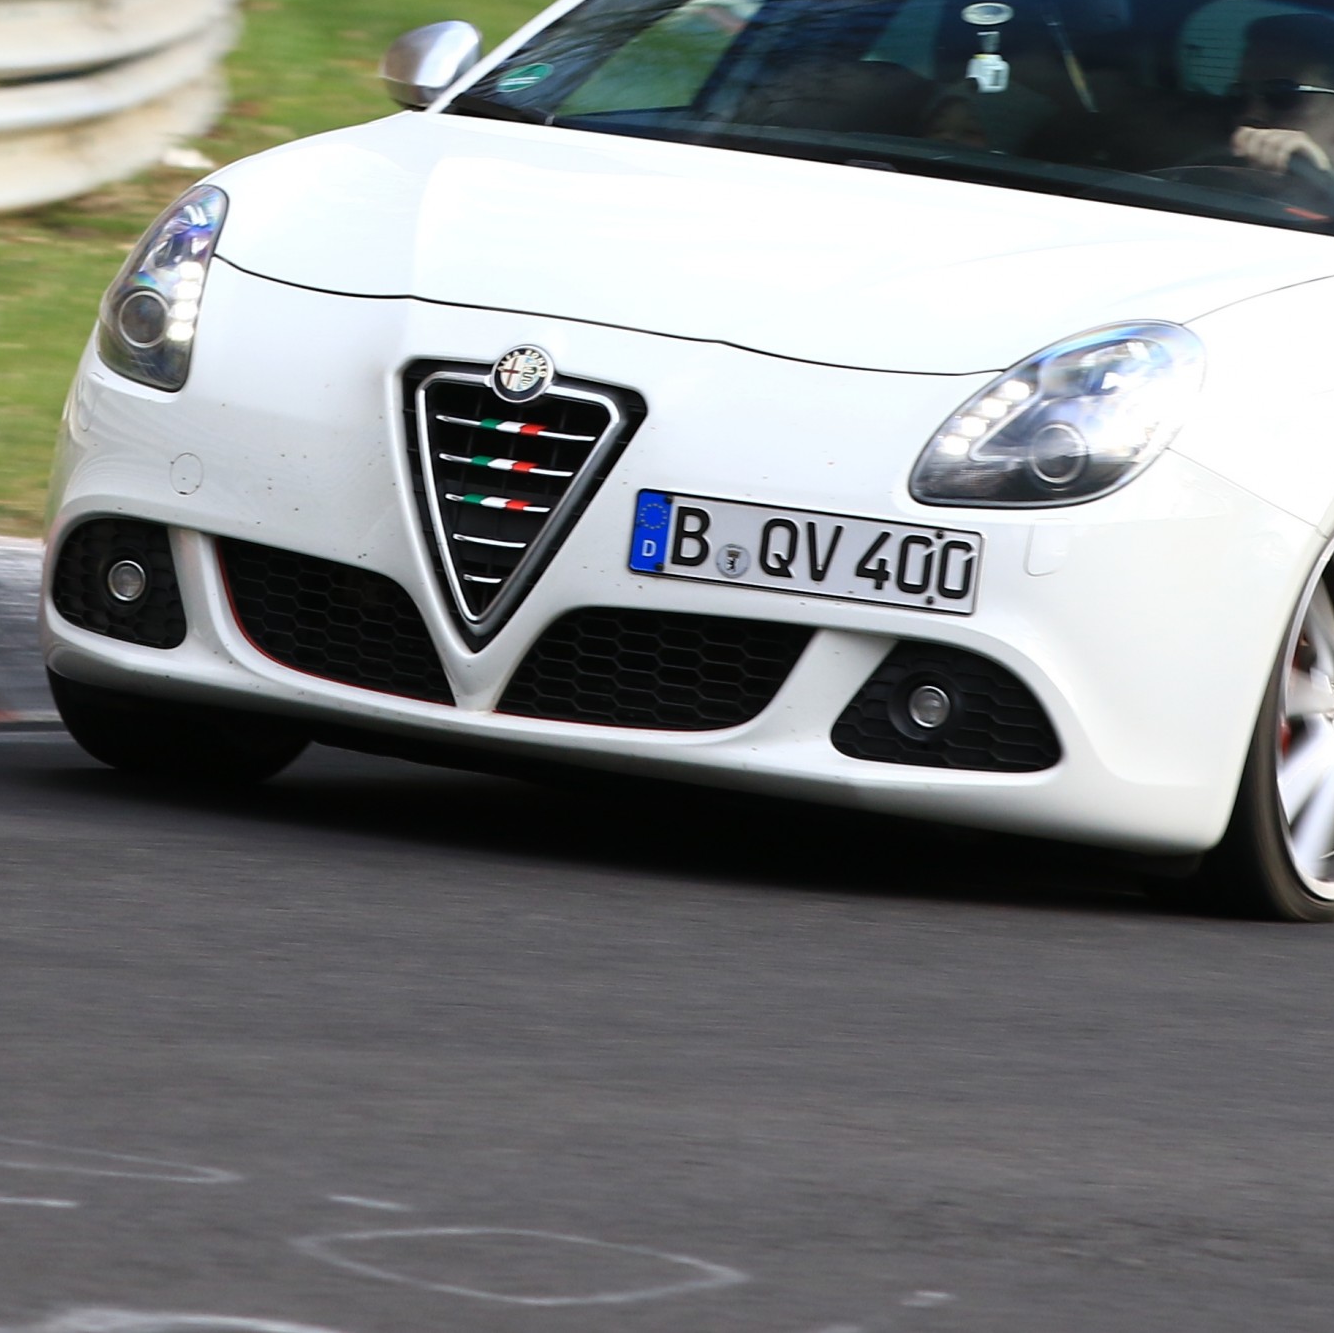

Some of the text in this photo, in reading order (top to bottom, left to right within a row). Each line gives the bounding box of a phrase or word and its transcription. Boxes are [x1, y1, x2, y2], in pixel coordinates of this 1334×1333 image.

[524, 349, 547, 378] ROMEO
[641, 539, 657, 557] D
[671, 505, 975, 599] B QV 400
